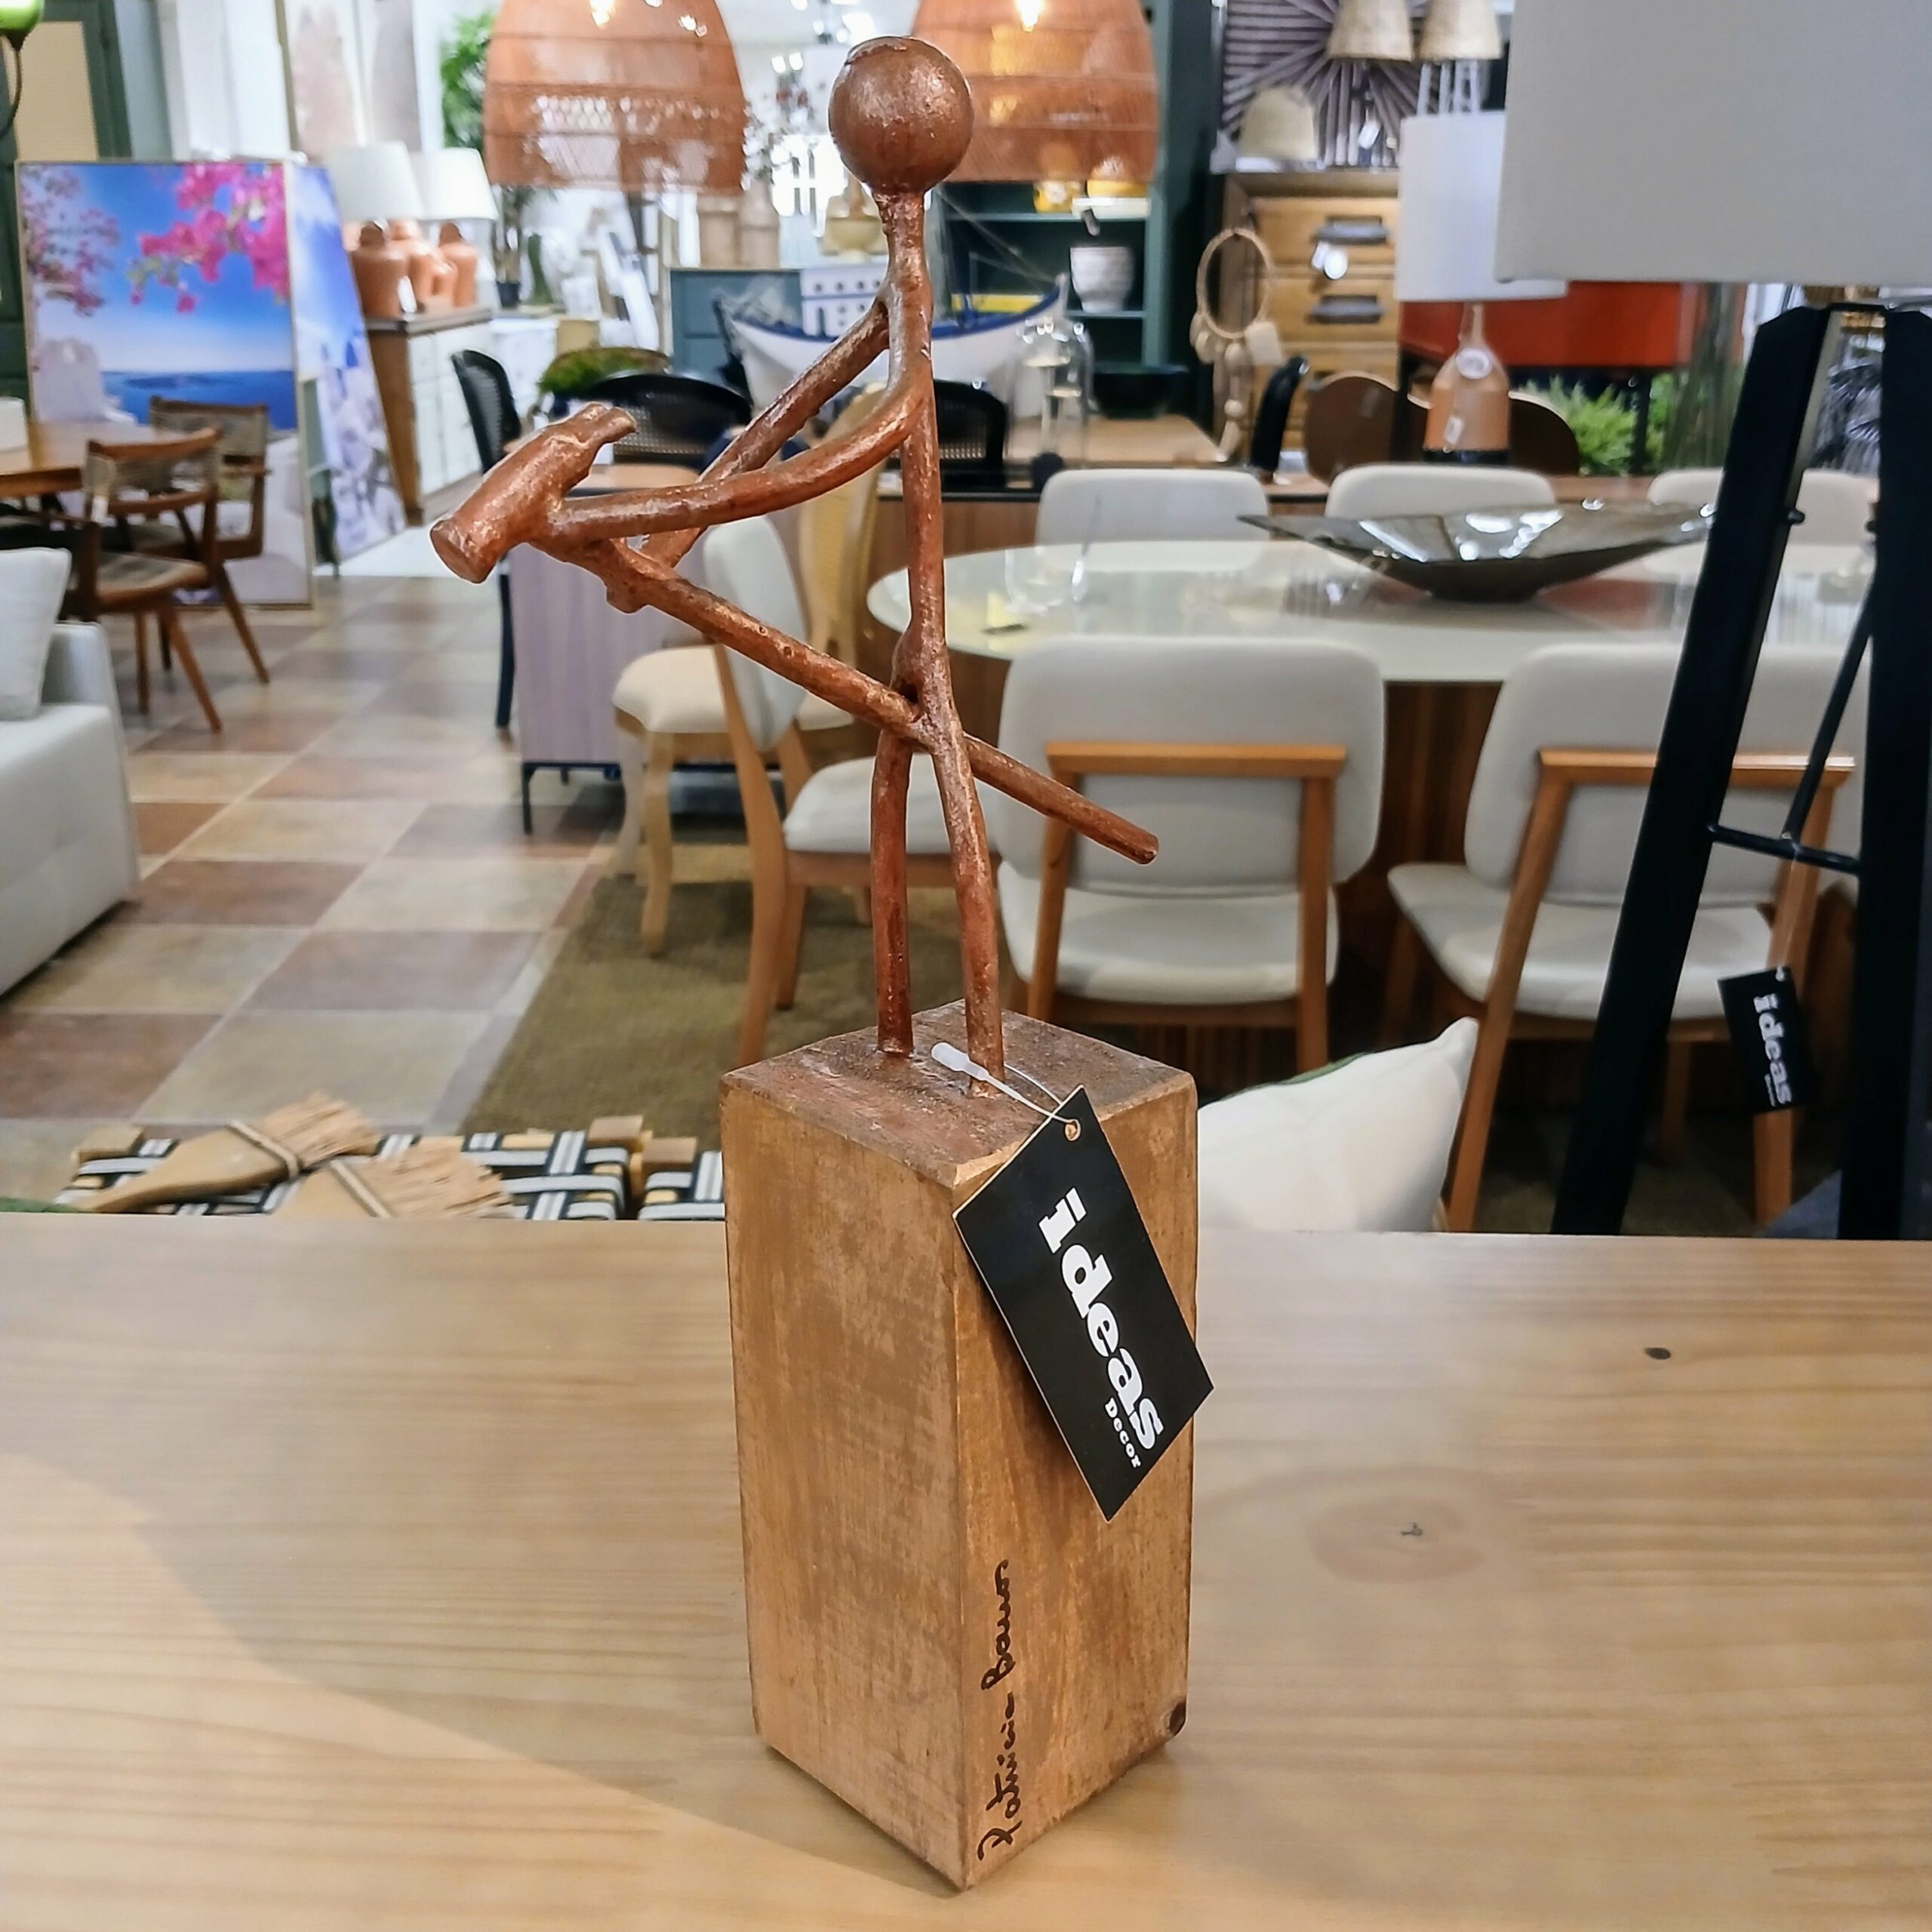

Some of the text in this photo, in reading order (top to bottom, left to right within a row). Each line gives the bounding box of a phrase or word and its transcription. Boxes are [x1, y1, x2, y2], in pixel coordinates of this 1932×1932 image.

[1752, 992, 1792, 1104] ideas
[1038, 1187, 1164, 1450] ideas
[1105, 1397, 1141, 1468] Decor
[977, 1692, 1023, 1862] Patricia
